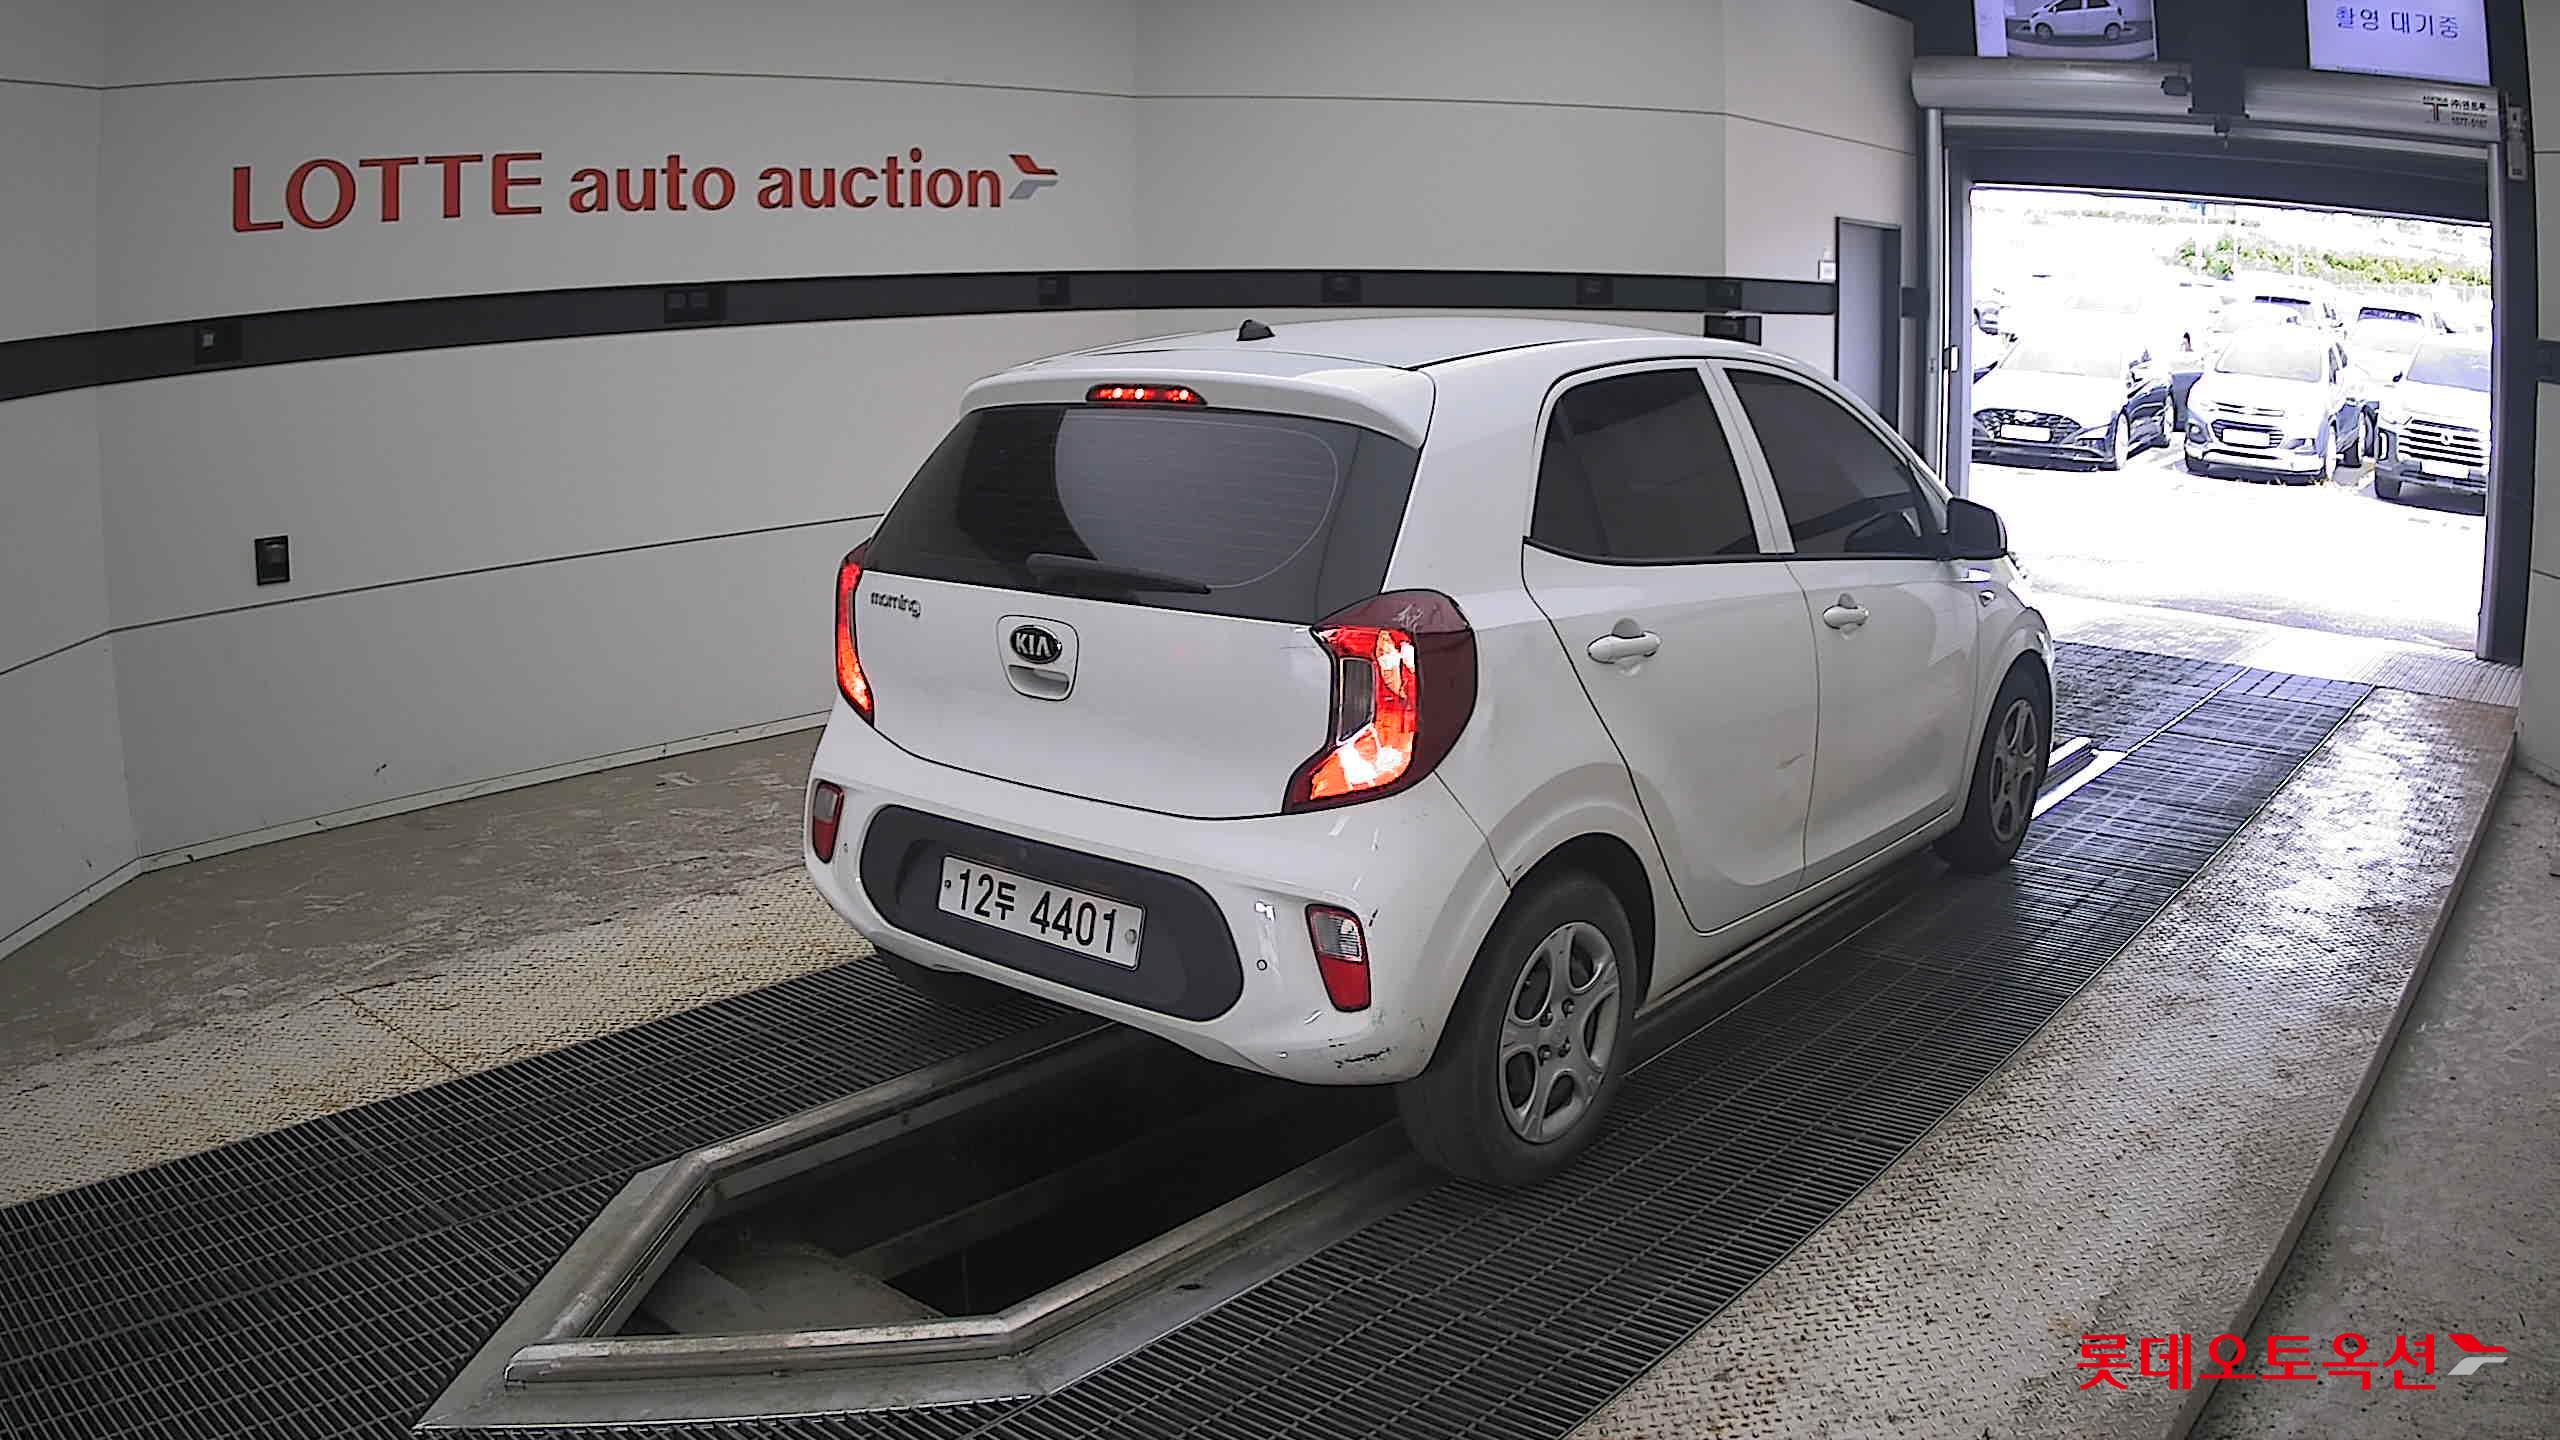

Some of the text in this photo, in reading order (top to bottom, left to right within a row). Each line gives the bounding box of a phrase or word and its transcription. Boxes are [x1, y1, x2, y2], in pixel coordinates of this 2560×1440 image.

[2391, 11, 2458, 39] 대기중
[232, 146, 1002, 233] LOTTE auto auction
[870, 591, 922, 618] morning
[1014, 631, 1053, 658] KIA
[959, 868, 1117, 954] 12두 4401
